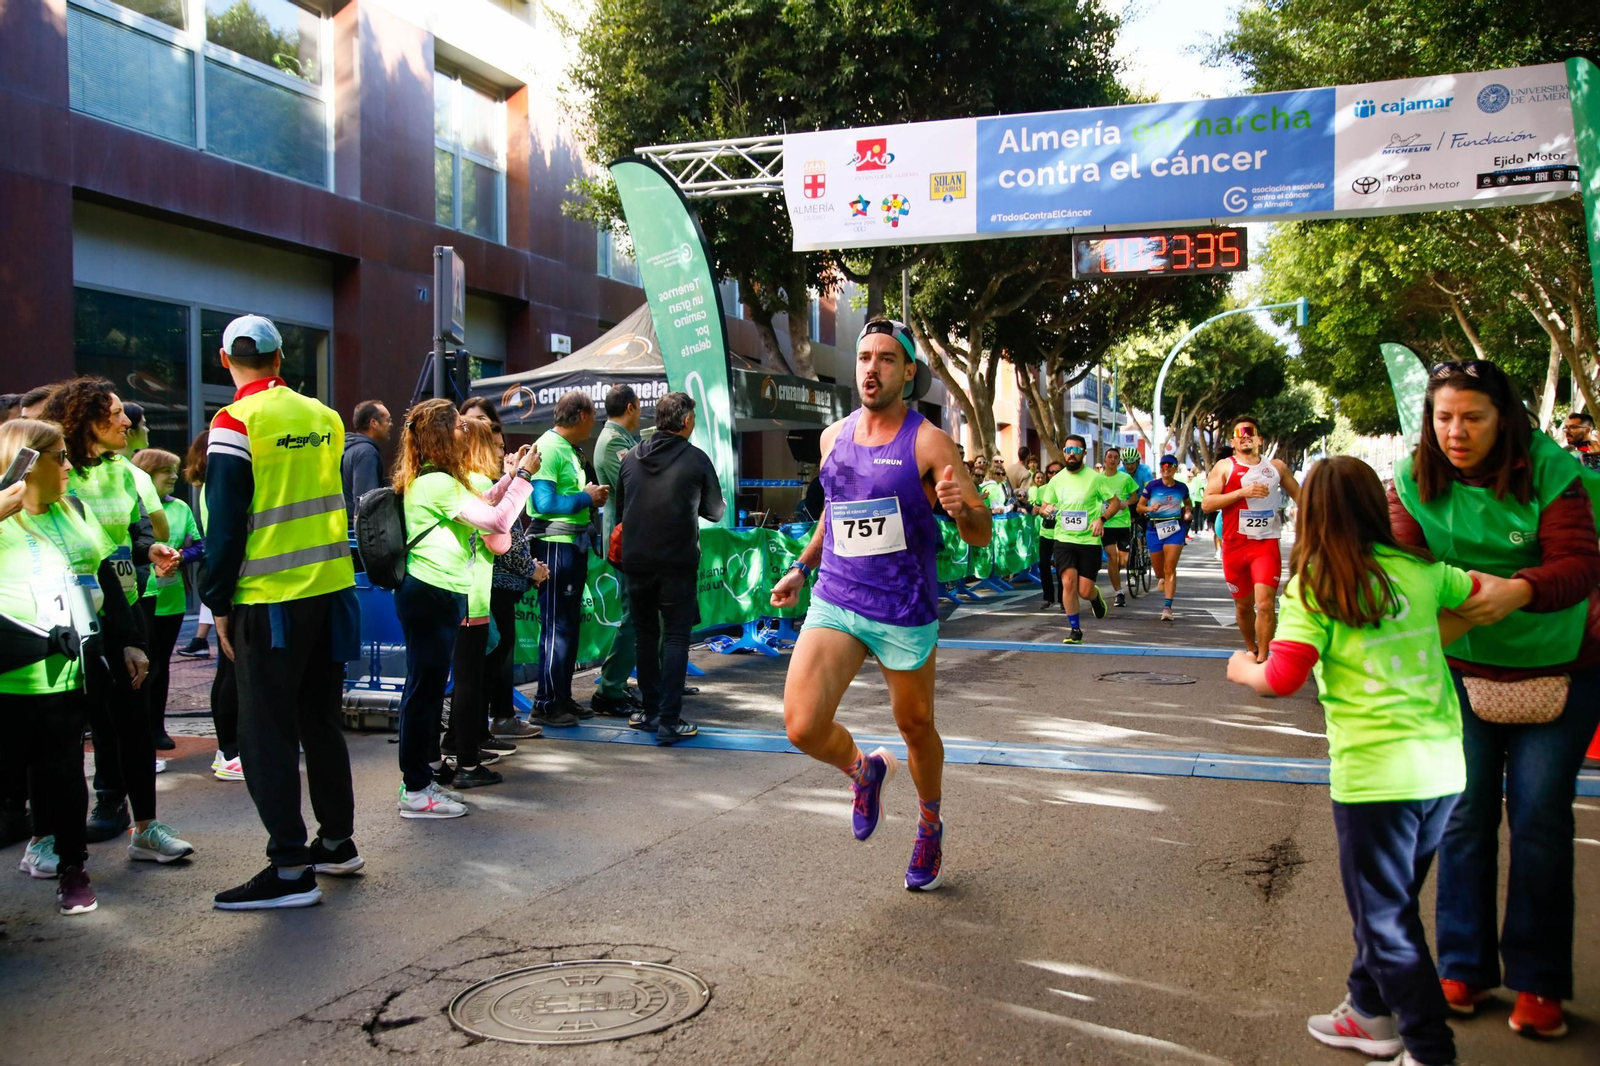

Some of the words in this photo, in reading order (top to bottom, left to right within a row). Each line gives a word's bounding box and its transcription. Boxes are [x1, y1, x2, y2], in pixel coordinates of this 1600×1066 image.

[1510, 84, 1569, 97] UNIVERSIDA
[1510, 96, 1525, 105] DE
[1528, 91, 1569, 103] ALMERÍ
[1380, 97, 1454, 116] cajamar
[998, 120, 1122, 154] Almería
[1132, 121, 1171, 141] en
[1184, 106, 1312, 138] marcha
[1450, 130, 1537, 149] Fundación
[1381, 146, 1432, 155] MICHELIN
[1494, 154, 1524, 168] Ejido
[1527, 151, 1567, 163] Motor
[998, 160, 1101, 188] contra
[1110, 153, 1141, 180] el
[1150, 149, 1267, 178] cáncer
[934, 174, 962, 187] SOLAN
[1386, 173, 1421, 183] Toyota
[1512, 174, 1531, 182] Jeep
[1535, 171, 1549, 181] FIAT
[1251, 185, 1291, 194] asociación
[1292, 181, 1325, 192] española
[1385, 183, 1426, 194] Alborán
[1429, 181, 1460, 190] Motor
[1252, 193, 1277, 201] contra
[1277, 191, 1284, 199] el
[1284, 189, 1310, 199] cáncer
[793, 203, 835, 215] ALMERÍA
[1264, 200, 1294, 209] Almería
[990, 208, 1092, 222] #TodosContraElCáncer
[873, 458, 903, 466] KIPRUN
[1064, 516, 1082, 525] 545
[1246, 518, 1269, 528] 225
[843, 517, 887, 539] 757
[1161, 525, 1176, 534] 128
[110, 560, 133, 577] 00
